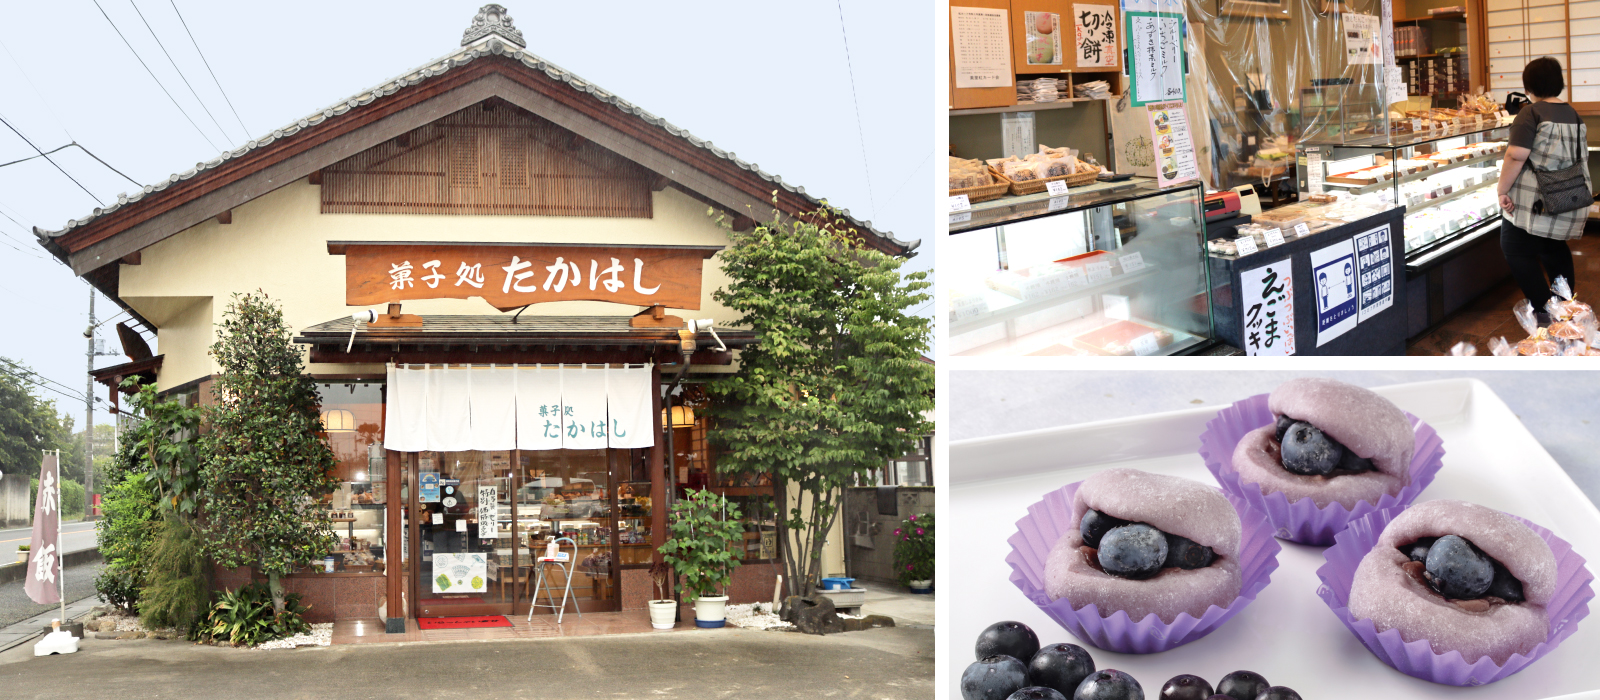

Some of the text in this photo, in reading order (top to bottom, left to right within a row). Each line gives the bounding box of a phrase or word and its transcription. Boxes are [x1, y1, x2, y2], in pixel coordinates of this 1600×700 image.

[1079, 10, 1103, 64] 切り餅
[1100, 10, 1115, 44] 冷凍
[1104, 45, 1116, 66] 真空
[388, 255, 662, 295] 菓子処 たかはし
[1262, 267, 1286, 349] えごま
[538, 404, 574, 418] 菓子処
[542, 418, 627, 439] たかはし
[32, 470, 56, 585] 赤飯
